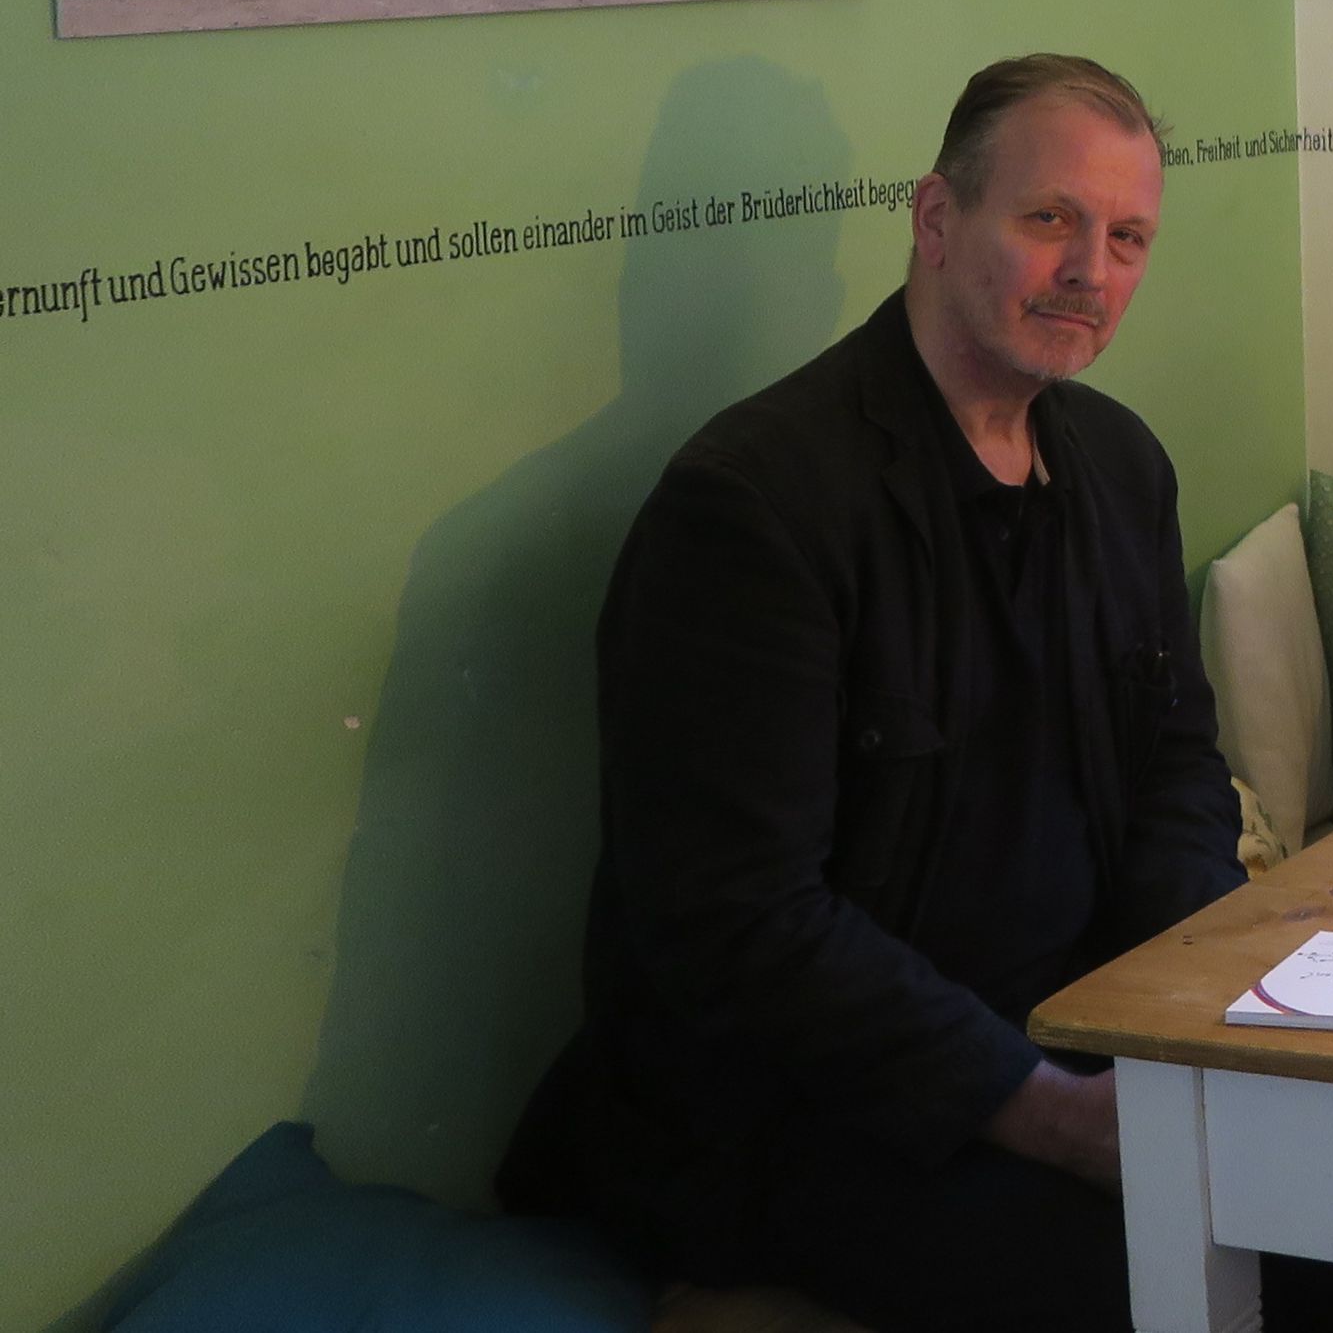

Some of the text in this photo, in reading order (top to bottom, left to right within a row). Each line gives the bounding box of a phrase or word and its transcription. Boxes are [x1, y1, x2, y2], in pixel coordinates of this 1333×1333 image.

[1196, 134, 1242, 165] Freiheit
[1245, 131, 1268, 158] und
[1269, 128, 1333, 156] Sicherheit
[109, 177, 868, 304] und Gewissen begabt und sollen einander im Geist der Brüderlichkeit
